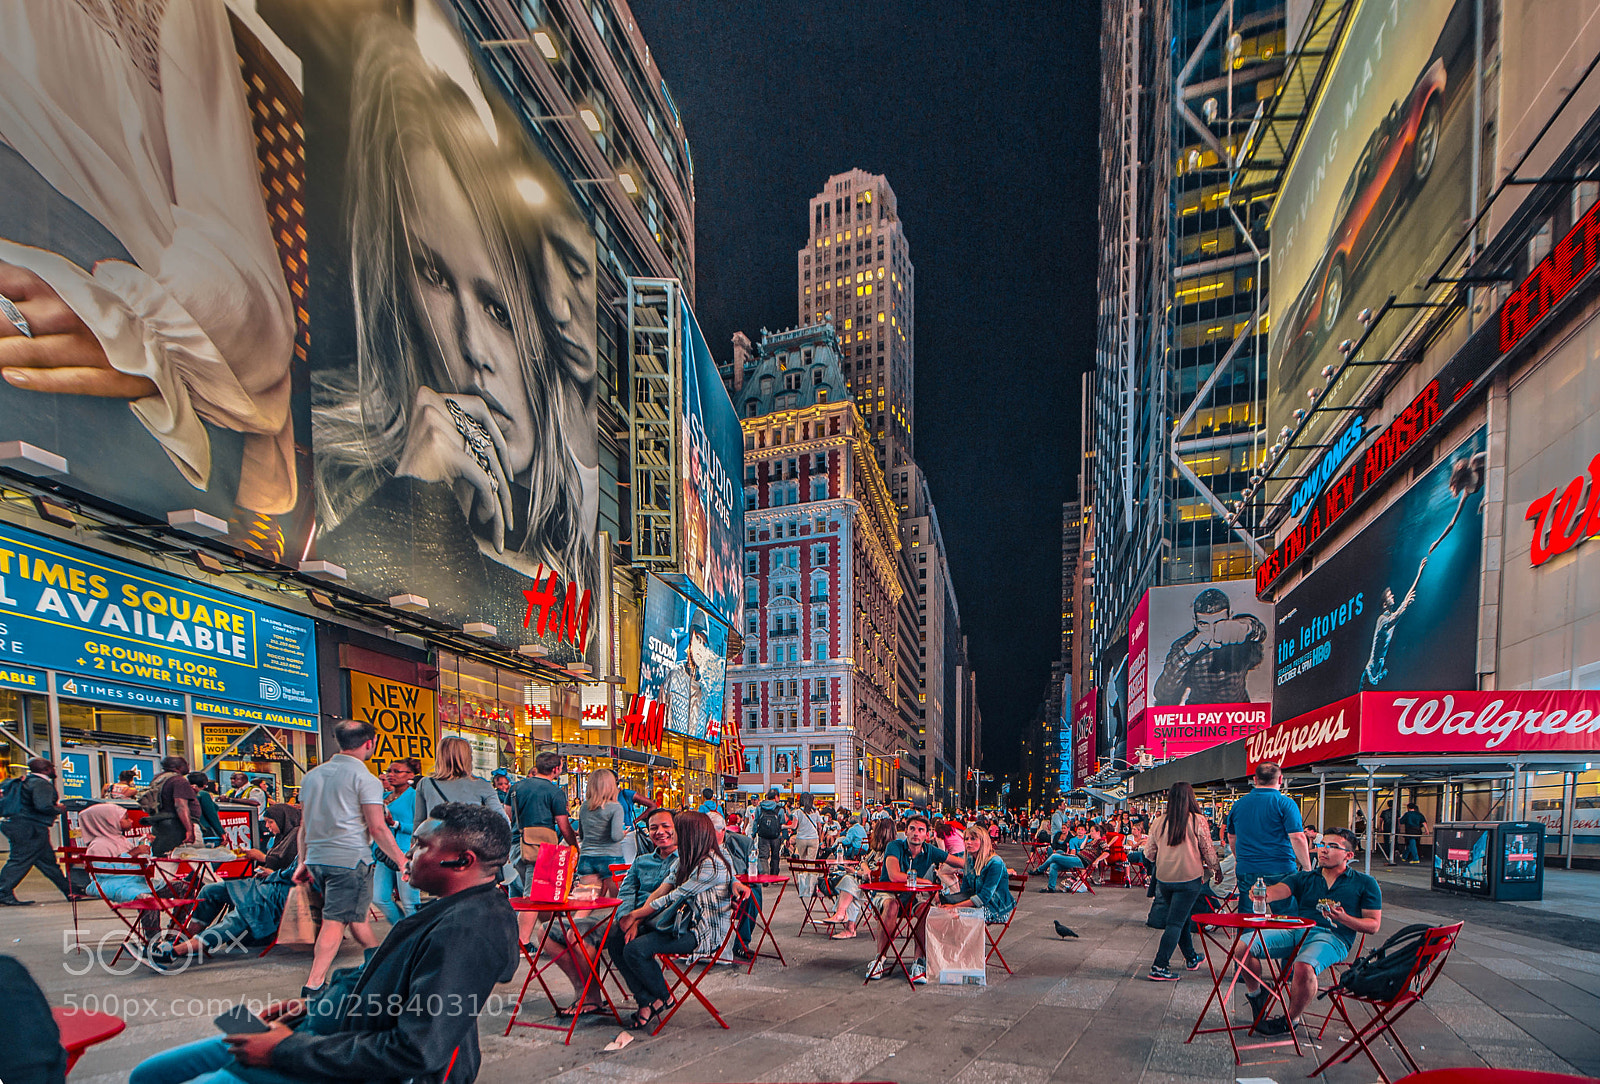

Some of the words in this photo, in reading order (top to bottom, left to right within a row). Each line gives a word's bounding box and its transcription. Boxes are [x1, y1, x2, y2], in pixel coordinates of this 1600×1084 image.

[1277, 129, 1339, 274] DRIVING
[691, 412, 734, 511] STUDIO
[1310, 506, 1321, 543] A
[1325, 465, 1357, 527] NEW
[1362, 379, 1444, 491] ADVISER
[1291, 464, 1322, 518] DOW
[0, 549, 109, 599] TIMES
[122, 584, 245, 635] SQUARE
[523, 563, 591, 655] H&M
[35, 587, 247, 659] AVAILABLE
[1278, 638, 1295, 665] the
[1300, 592, 1364, 651] leftovers
[84, 641, 163, 667] GROUND
[168, 658, 217, 678] FLOOR
[649, 636, 677, 662] STUDIO
[1312, 641, 1331, 667] HBO
[62, 678, 77, 694] 4
[81, 683, 123, 698] TIMES
[127, 691, 179, 706] SQUARE
[93, 657, 105, 670] 2
[112, 661, 171, 684] LOWER
[176, 673, 226, 692] LEVELS
[368, 682, 419, 710] NEW
[196, 702, 230, 716] RETAIL
[233, 706, 263, 720] SPACE
[265, 713, 312, 728] AVAILABLE
[361, 707, 428, 735] YORK
[618, 693, 666, 751] H&M
[1153, 725, 1227, 738] SWITCHING
[1154, 713, 1196, 726] WE'LL
[1198, 712, 1224, 725] PAY
[1226, 711, 1266, 724] YOUR
[1246, 709, 1350, 767] Walgreens
[814, 755, 828, 768] GAP
[554, 870, 564, 901] europa
